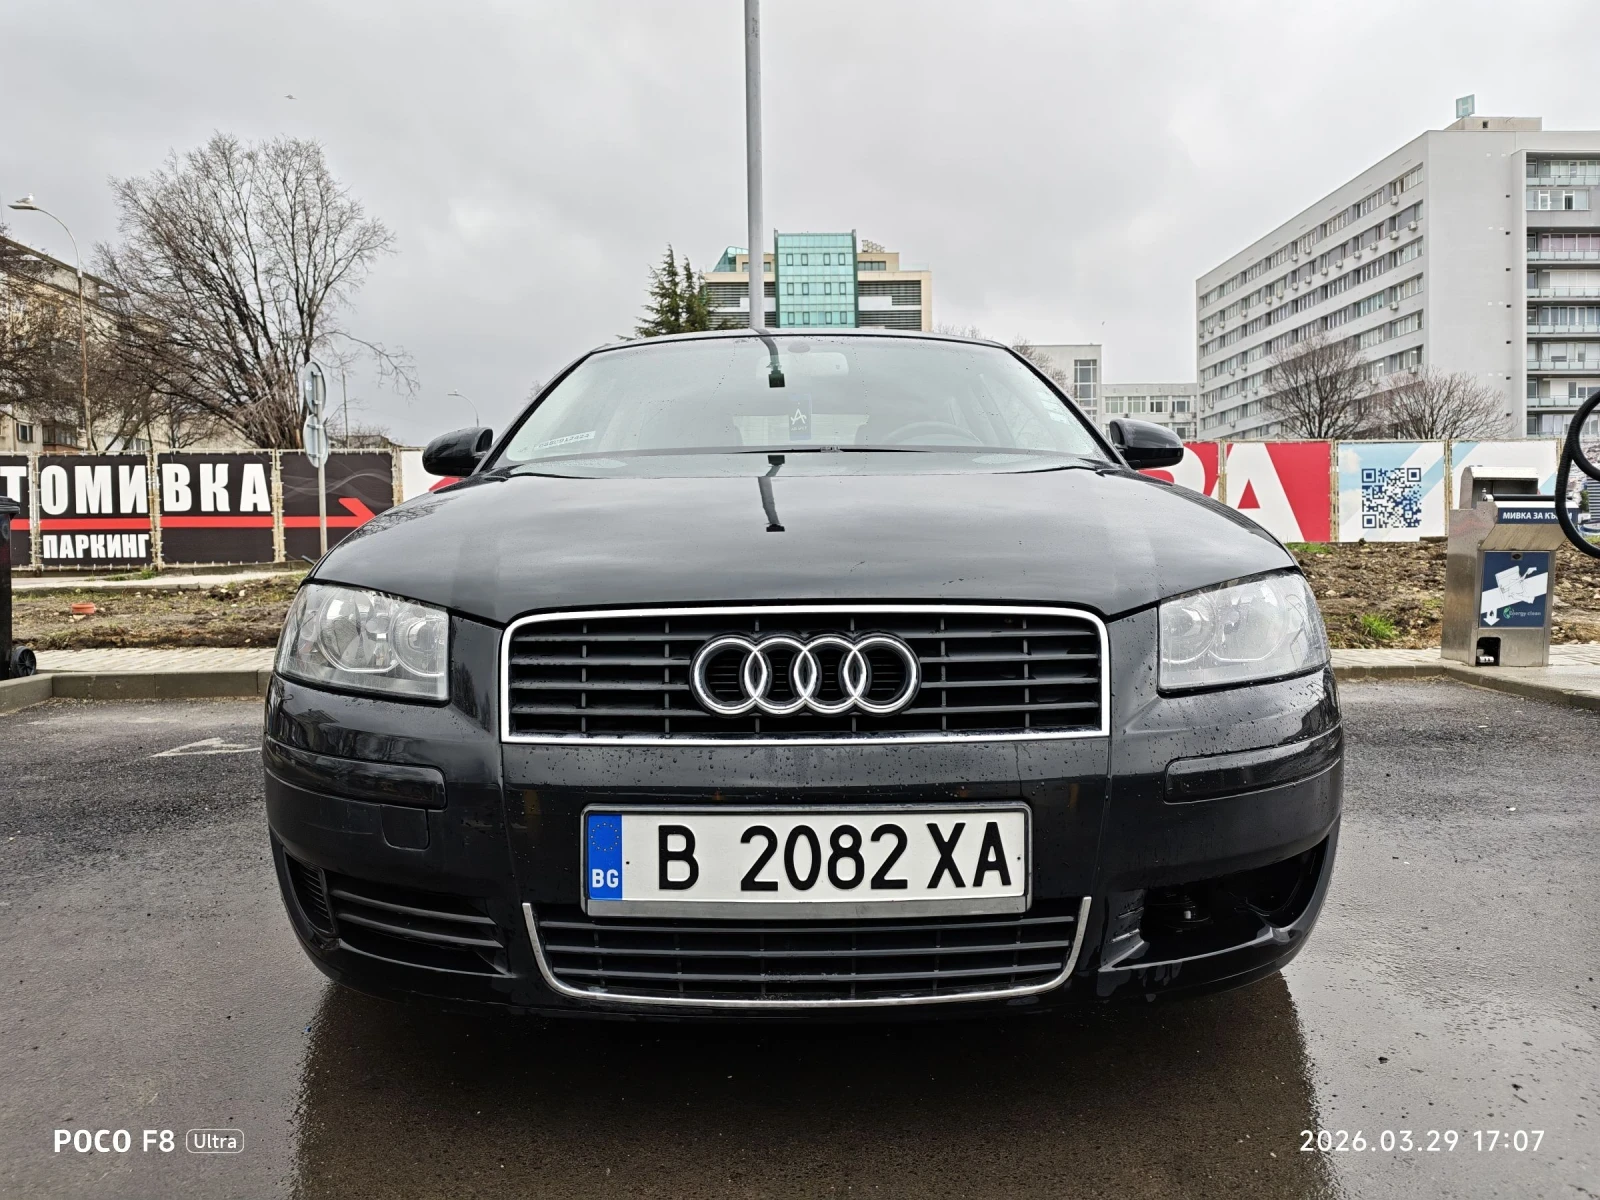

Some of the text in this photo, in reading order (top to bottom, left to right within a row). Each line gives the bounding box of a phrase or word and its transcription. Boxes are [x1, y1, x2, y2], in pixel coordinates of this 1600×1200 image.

[1502, 511, 1532, 520] МИВКА
[1533, 511, 1544, 520] ЗА
[43, 534, 149, 559] ПАРКИНГ
[658, 822, 1012, 892] B 2082 XA
[592, 869, 619, 888] BG
